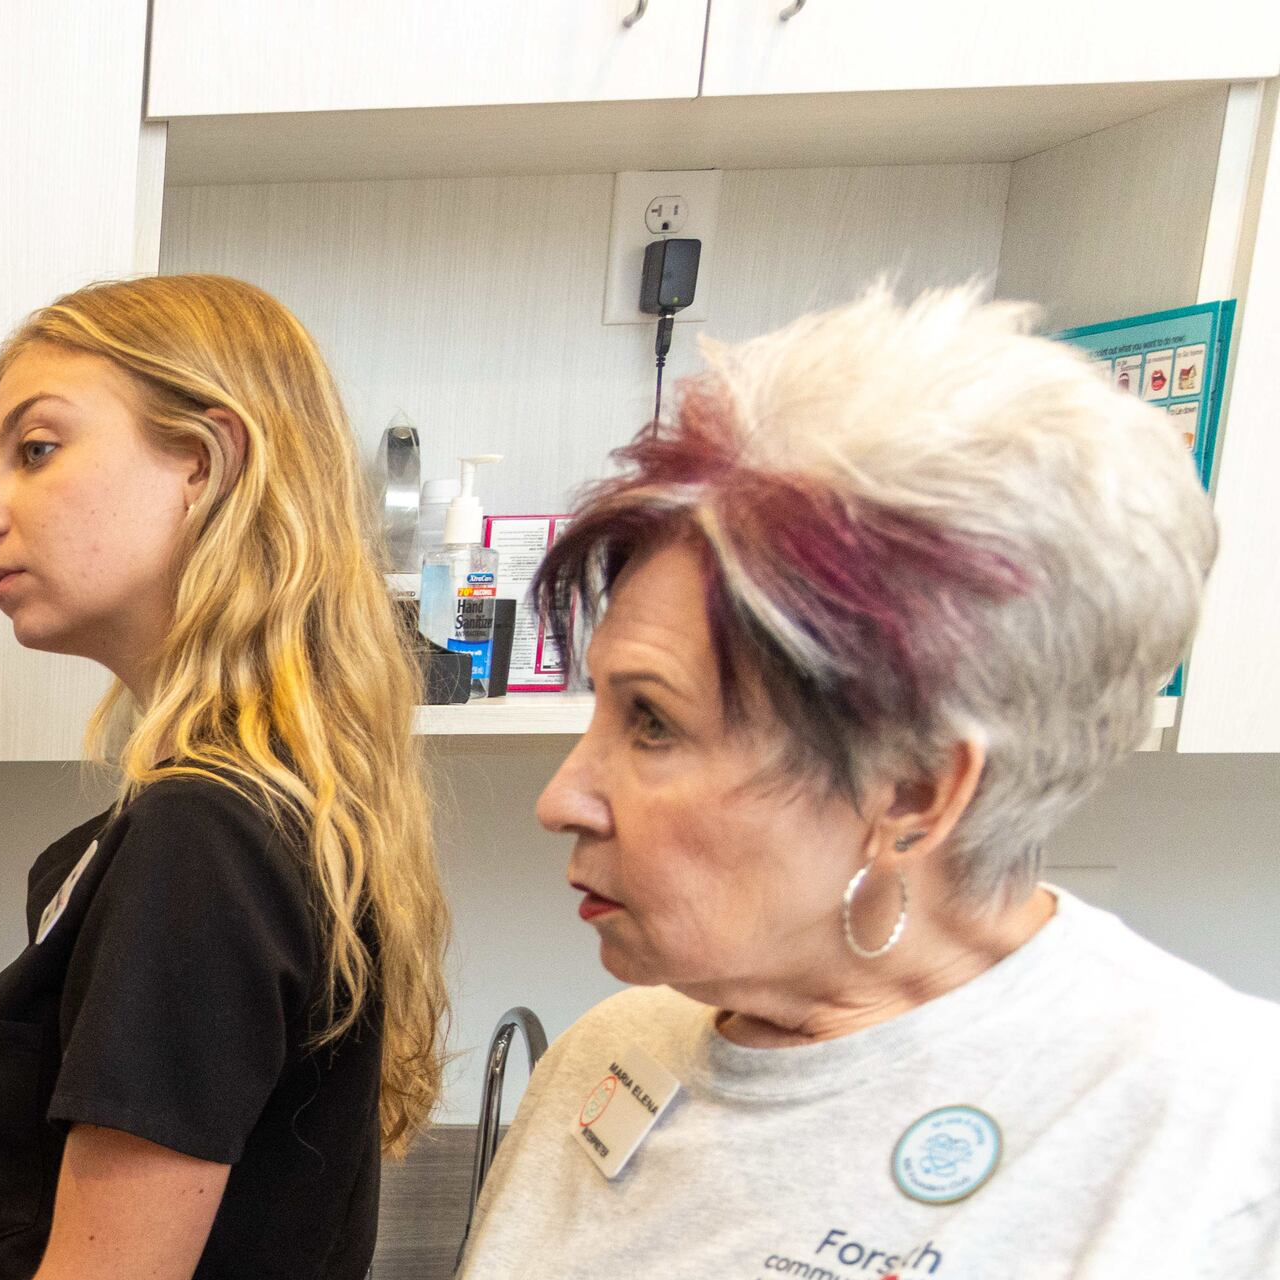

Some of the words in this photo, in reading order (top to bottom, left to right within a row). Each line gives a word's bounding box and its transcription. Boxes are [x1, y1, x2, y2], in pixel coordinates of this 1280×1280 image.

[456, 599, 485, 614] Hand
[608, 1062, 634, 1090] MARIA
[630, 1085, 659, 1116] ELENA
[815, 1228, 943, 1275] Forsh
